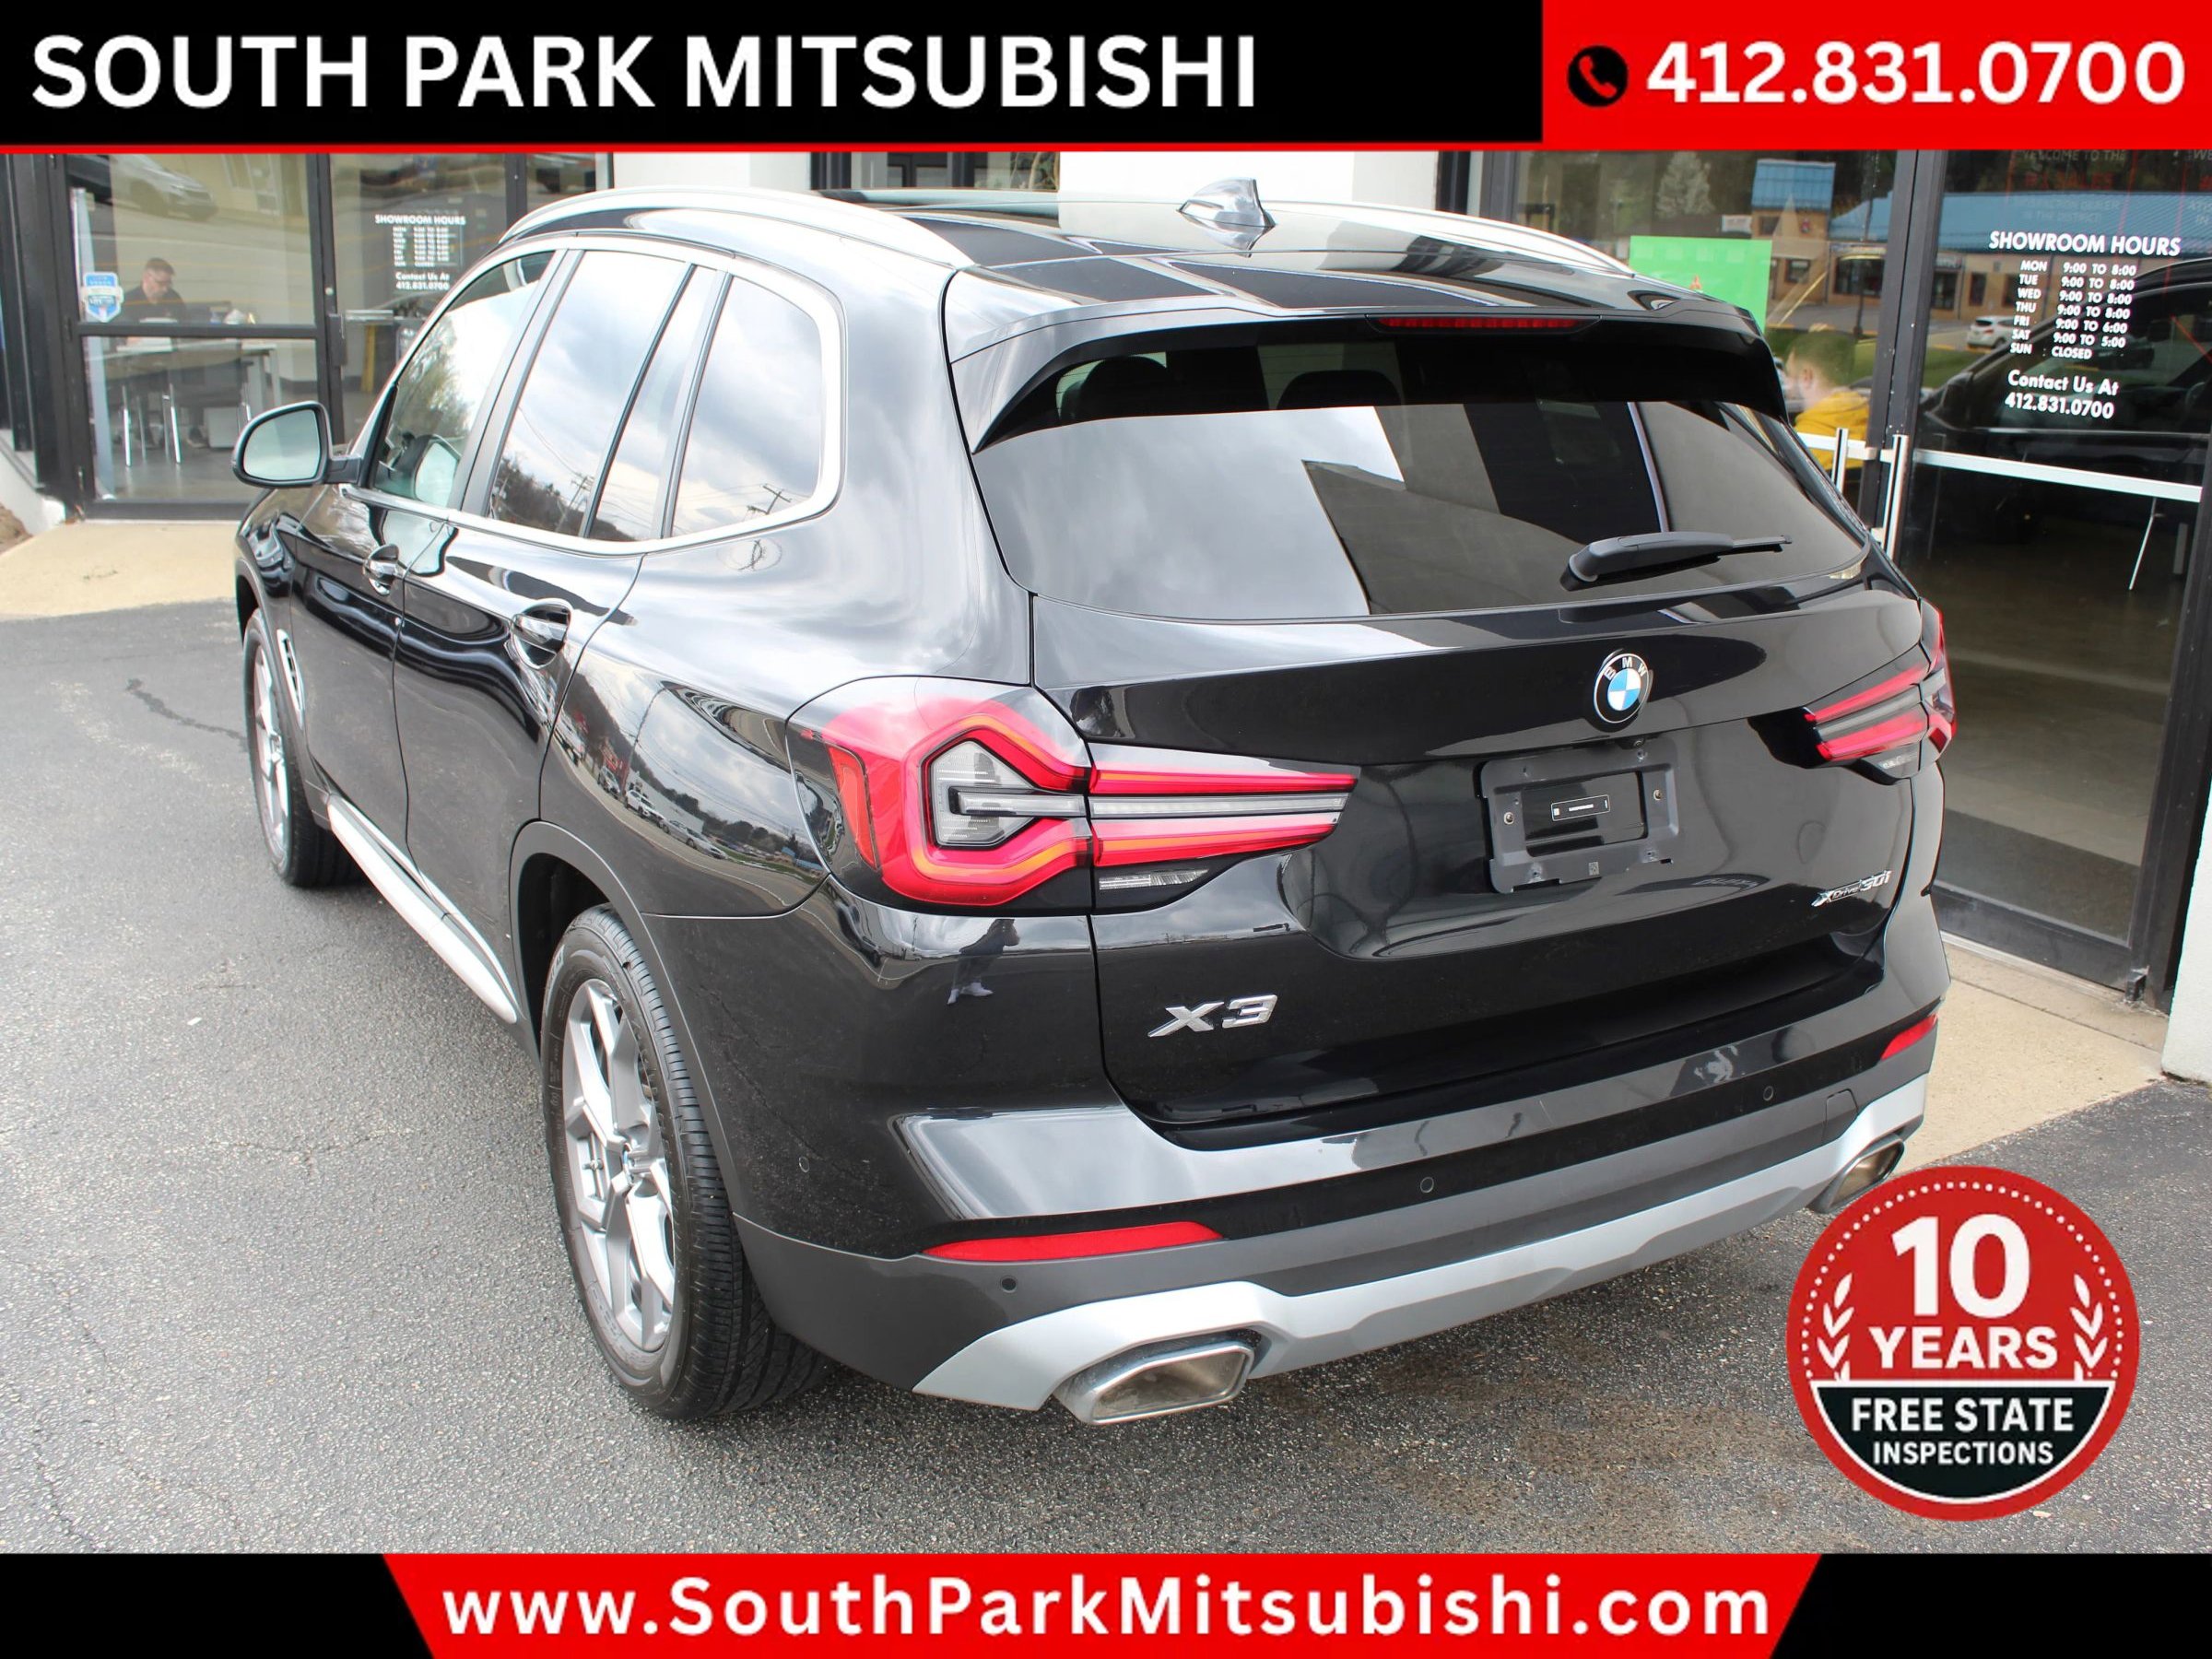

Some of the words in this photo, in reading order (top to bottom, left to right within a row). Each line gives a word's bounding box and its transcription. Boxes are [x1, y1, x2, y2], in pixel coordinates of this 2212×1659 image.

[375, 214, 432, 225] SHOWROOM
[433, 215, 466, 226] HOURS
[1989, 230, 2105, 253] SHOWROOM
[2111, 235, 2182, 257] HOURS
[2020, 260, 2048, 273] MON
[2063, 262, 2087, 274] 9:00
[2091, 263, 2107, 275] TO
[2112, 265, 2136, 276] 8:00
[2019, 274, 2039, 286] TUE
[2061, 276, 2085, 288] 9:00
[2088, 277, 2104, 289] TO
[2110, 279, 2136, 291] 8:00
[2017, 288, 2041, 300] WED
[2059, 290, 2083, 302] 9:00
[2088, 291, 2102, 303] TO
[2107, 293, 2133, 305] 8:00
[2016, 301, 2036, 313] THU
[2057, 304, 2081, 316] 9:00
[2086, 306, 2101, 318] TO
[2104, 308, 2131, 320] 8:00
[2014, 315, 2030, 326] FRI
[2055, 318, 2079, 330] 9:00
[2084, 320, 2099, 332] TO
[2102, 322, 2128, 334] 6:00
[2012, 329, 2031, 340] SAT
[2053, 332, 2077, 344] 9:00
[2079, 334, 2095, 346] TO
[2101, 335, 2126, 347] 5:00
[2010, 343, 2032, 355] SUN
[2051, 347, 2093, 359] CLOSED
[2007, 369, 2069, 392] Contact
[2073, 375, 2094, 394] Us
[2098, 378, 2119, 395] At
[2005, 392, 2114, 419] 412.831.0700
[1147, 994, 1277, 1038] X3
